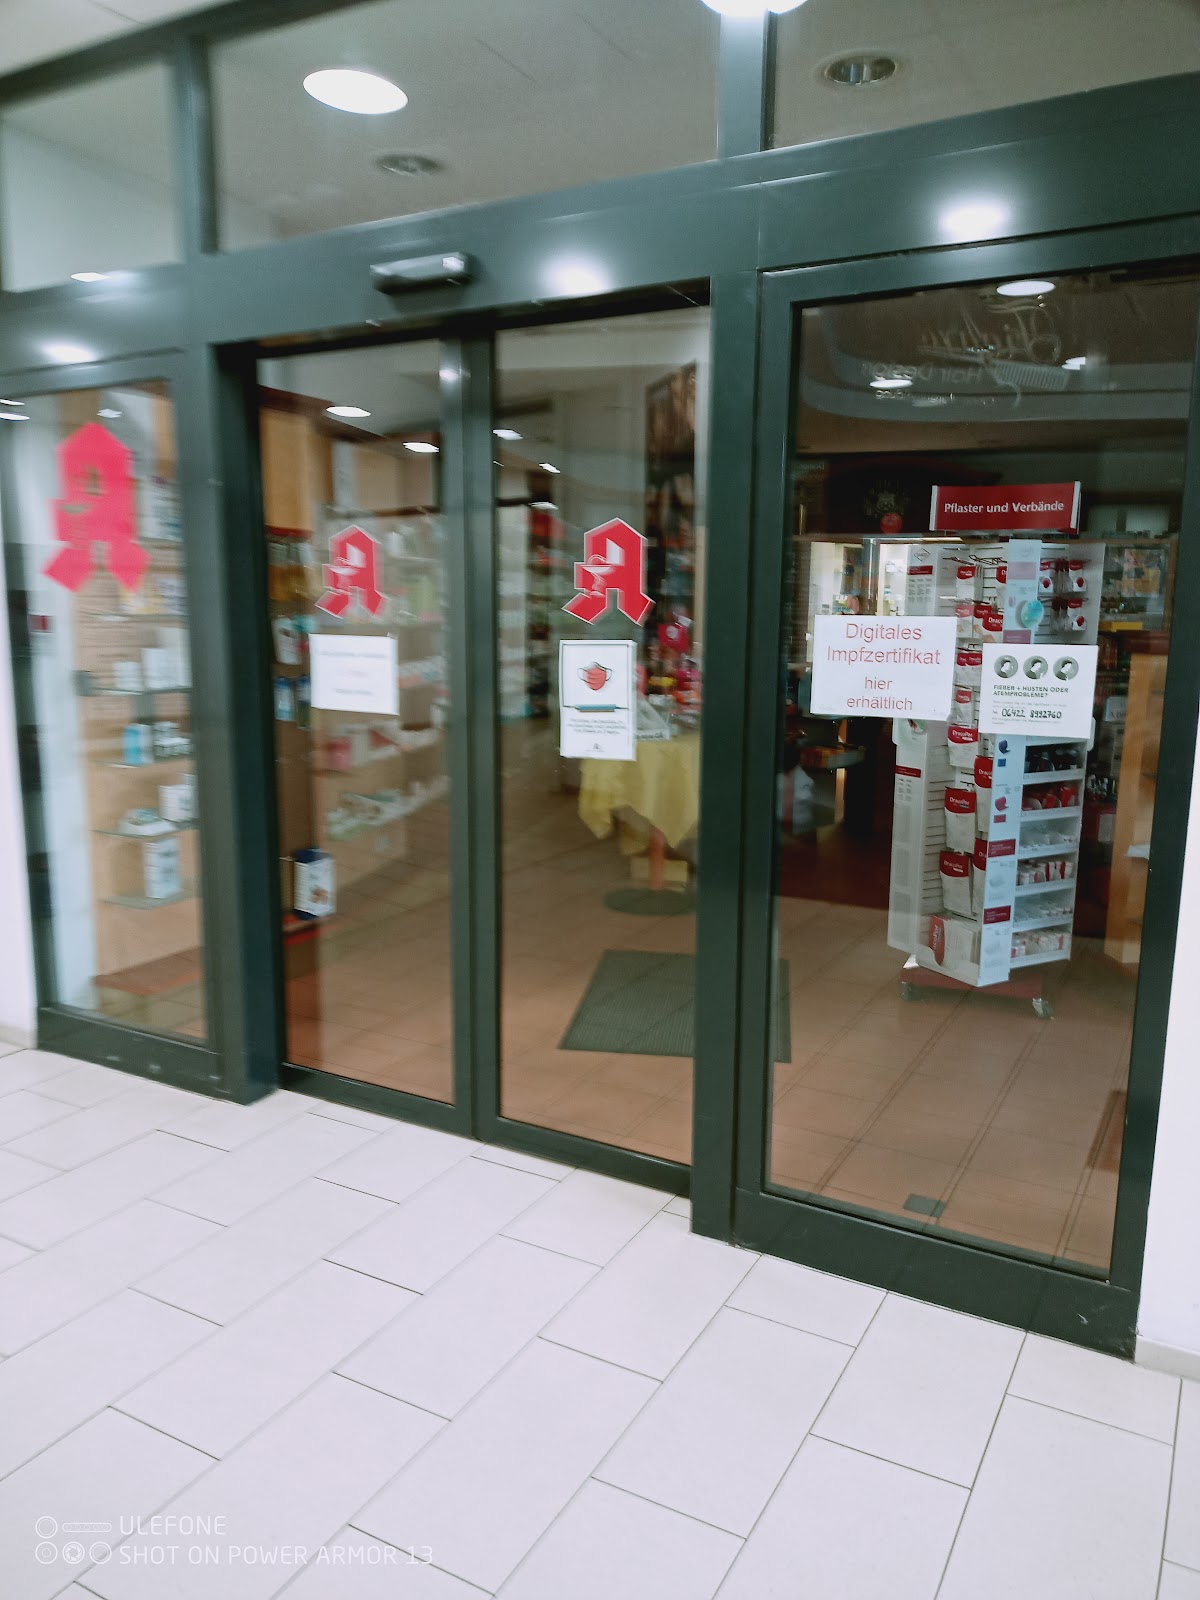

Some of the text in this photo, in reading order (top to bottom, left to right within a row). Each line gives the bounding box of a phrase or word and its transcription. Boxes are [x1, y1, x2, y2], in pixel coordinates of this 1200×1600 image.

[944, 501, 1064, 513] Pflaster und Verbände
[845, 623, 922, 643] Digitales
[827, 645, 941, 665] Impfzertifikat
[864, 676, 893, 690] hier
[846, 696, 913, 711] erhältlich
[1001, 708, 1026, 718] 06422
